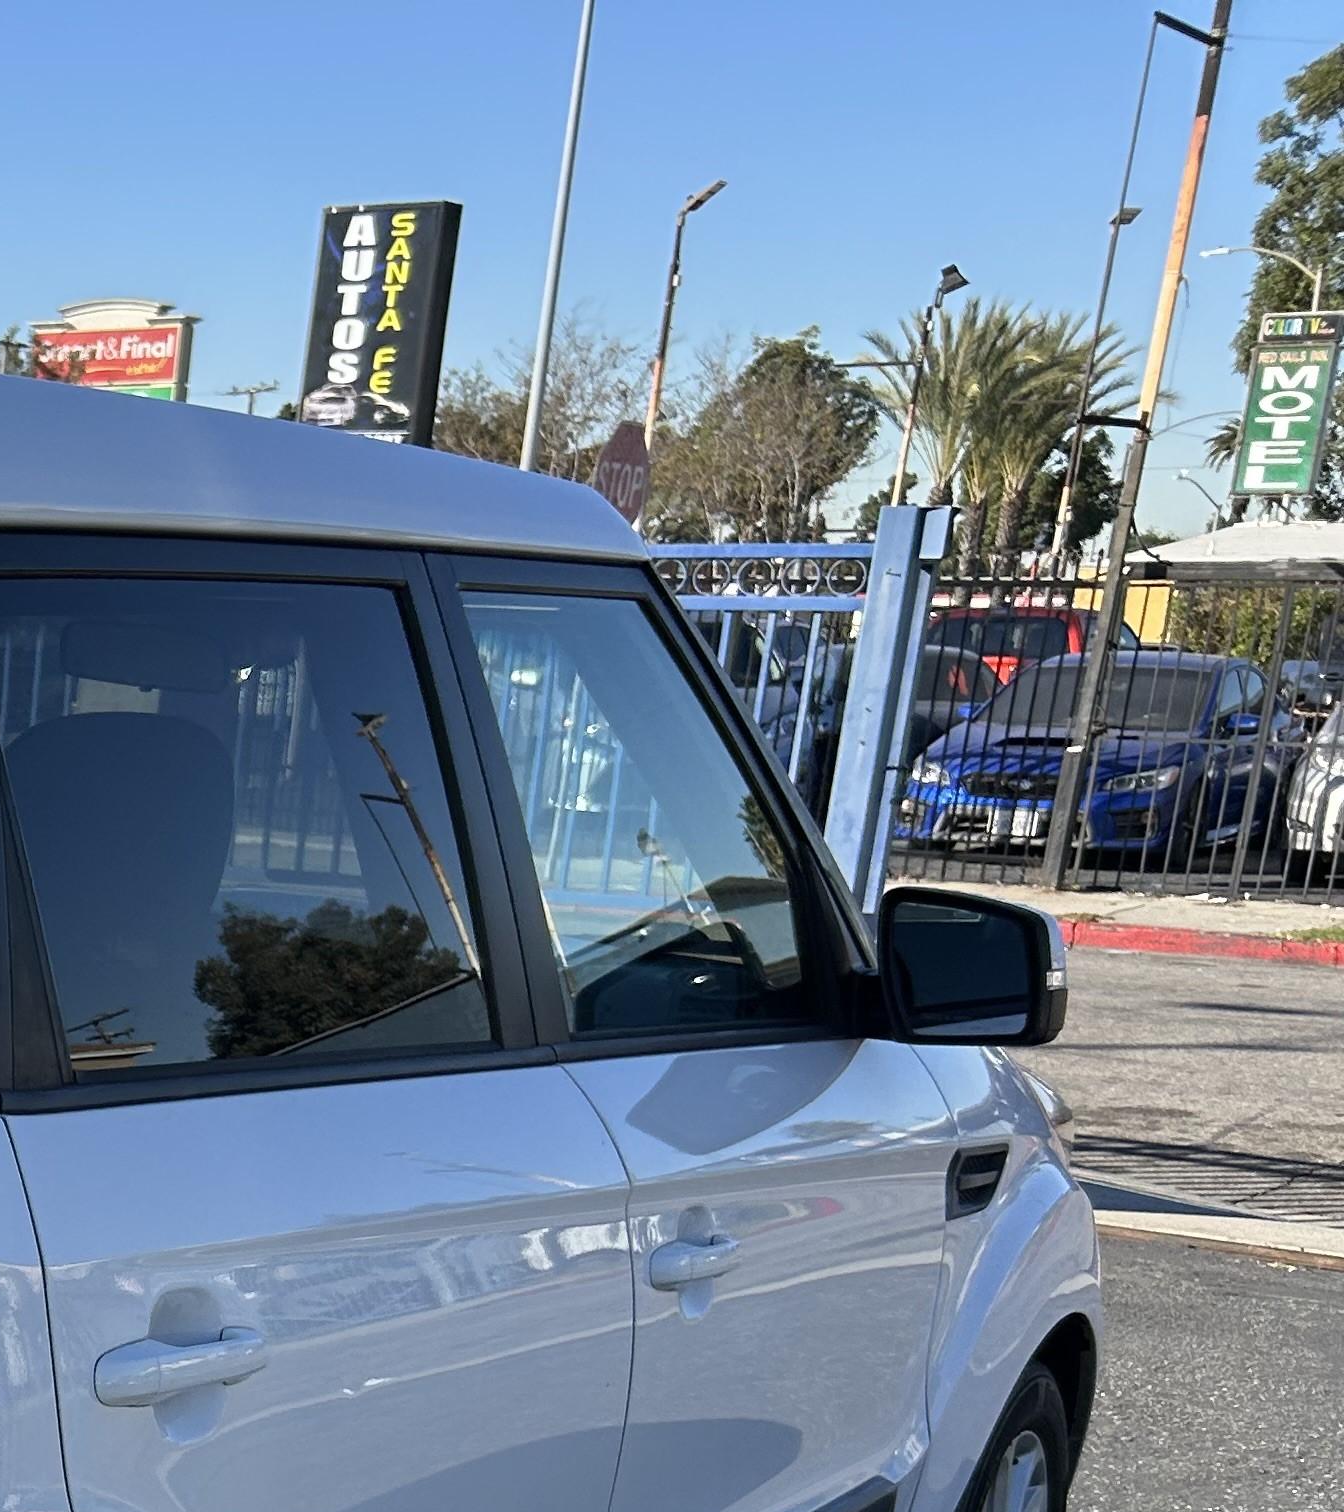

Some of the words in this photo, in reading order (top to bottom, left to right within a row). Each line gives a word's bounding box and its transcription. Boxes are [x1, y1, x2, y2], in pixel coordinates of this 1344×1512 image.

[328, 214, 376, 384] AUTOS
[376, 213, 416, 331] SANTA
[1264, 318, 1303, 336] COLOR
[369, 347, 397, 393] FE
[1243, 365, 1320, 489] MOTEL
[598, 460, 645, 509] STOP
